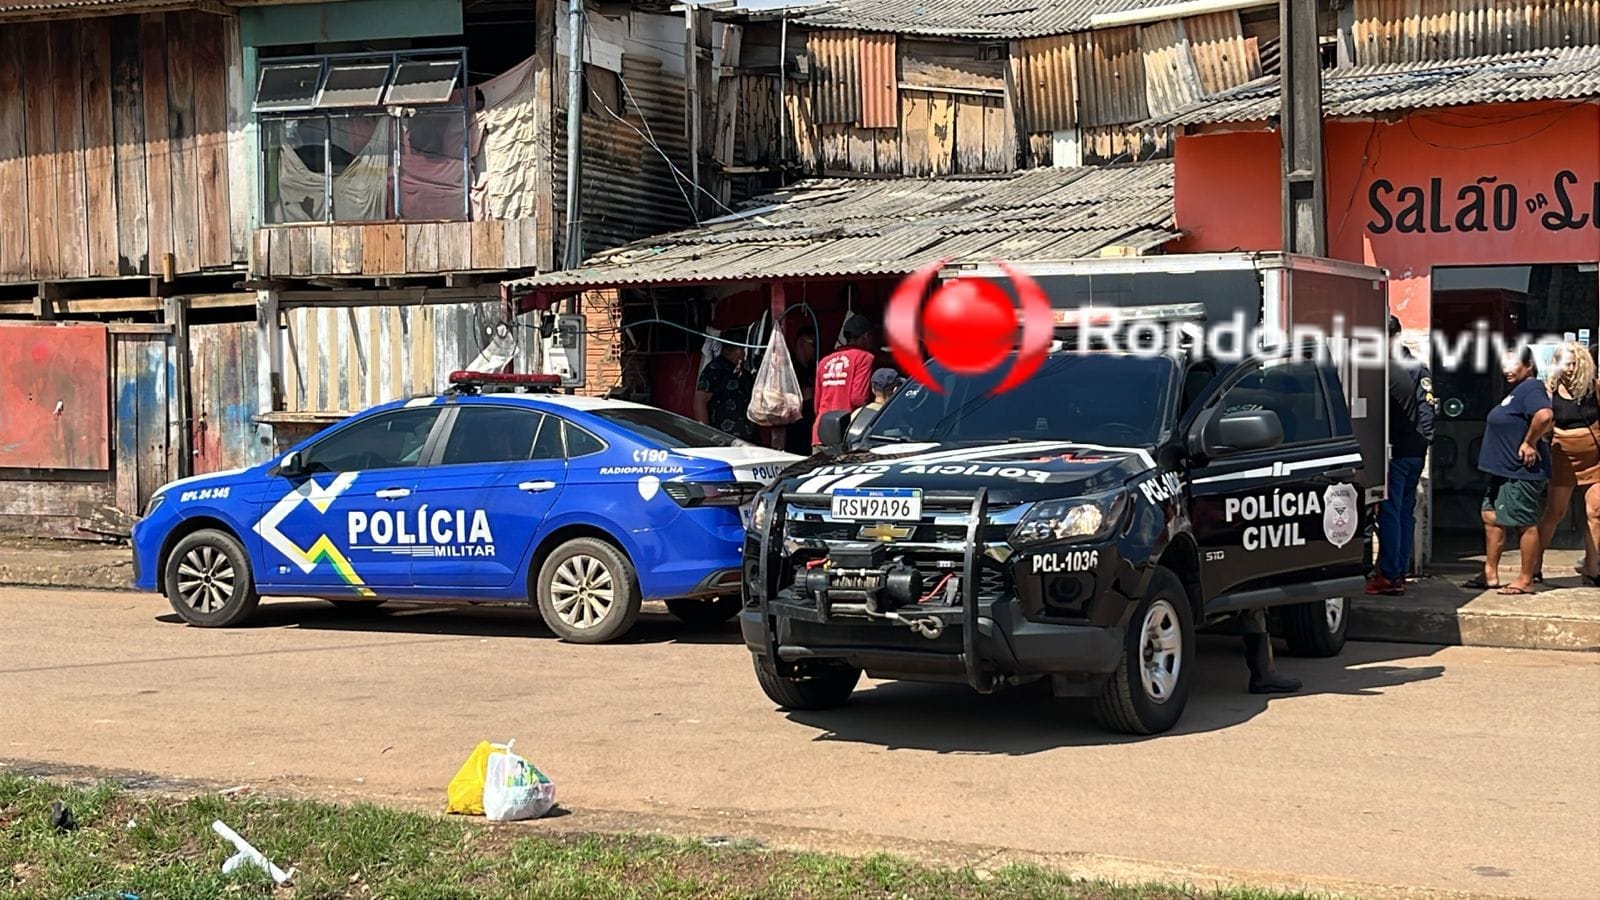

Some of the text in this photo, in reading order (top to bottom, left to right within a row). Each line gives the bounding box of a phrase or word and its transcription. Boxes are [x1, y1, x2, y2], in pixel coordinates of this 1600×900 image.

[1525, 192, 1549, 214] DA
[641, 449, 669, 462] 190
[599, 465, 685, 475] RADIOPATRULHA
[838, 498, 911, 517] RSW9A96
[1225, 488, 1321, 522] POLÍCIA
[348, 503, 494, 545] POLÍCIA
[1242, 522, 1306, 551] CIVIL
[434, 545, 496, 557] MILITAR
[1032, 549, 1099, 574] PCL-1036
